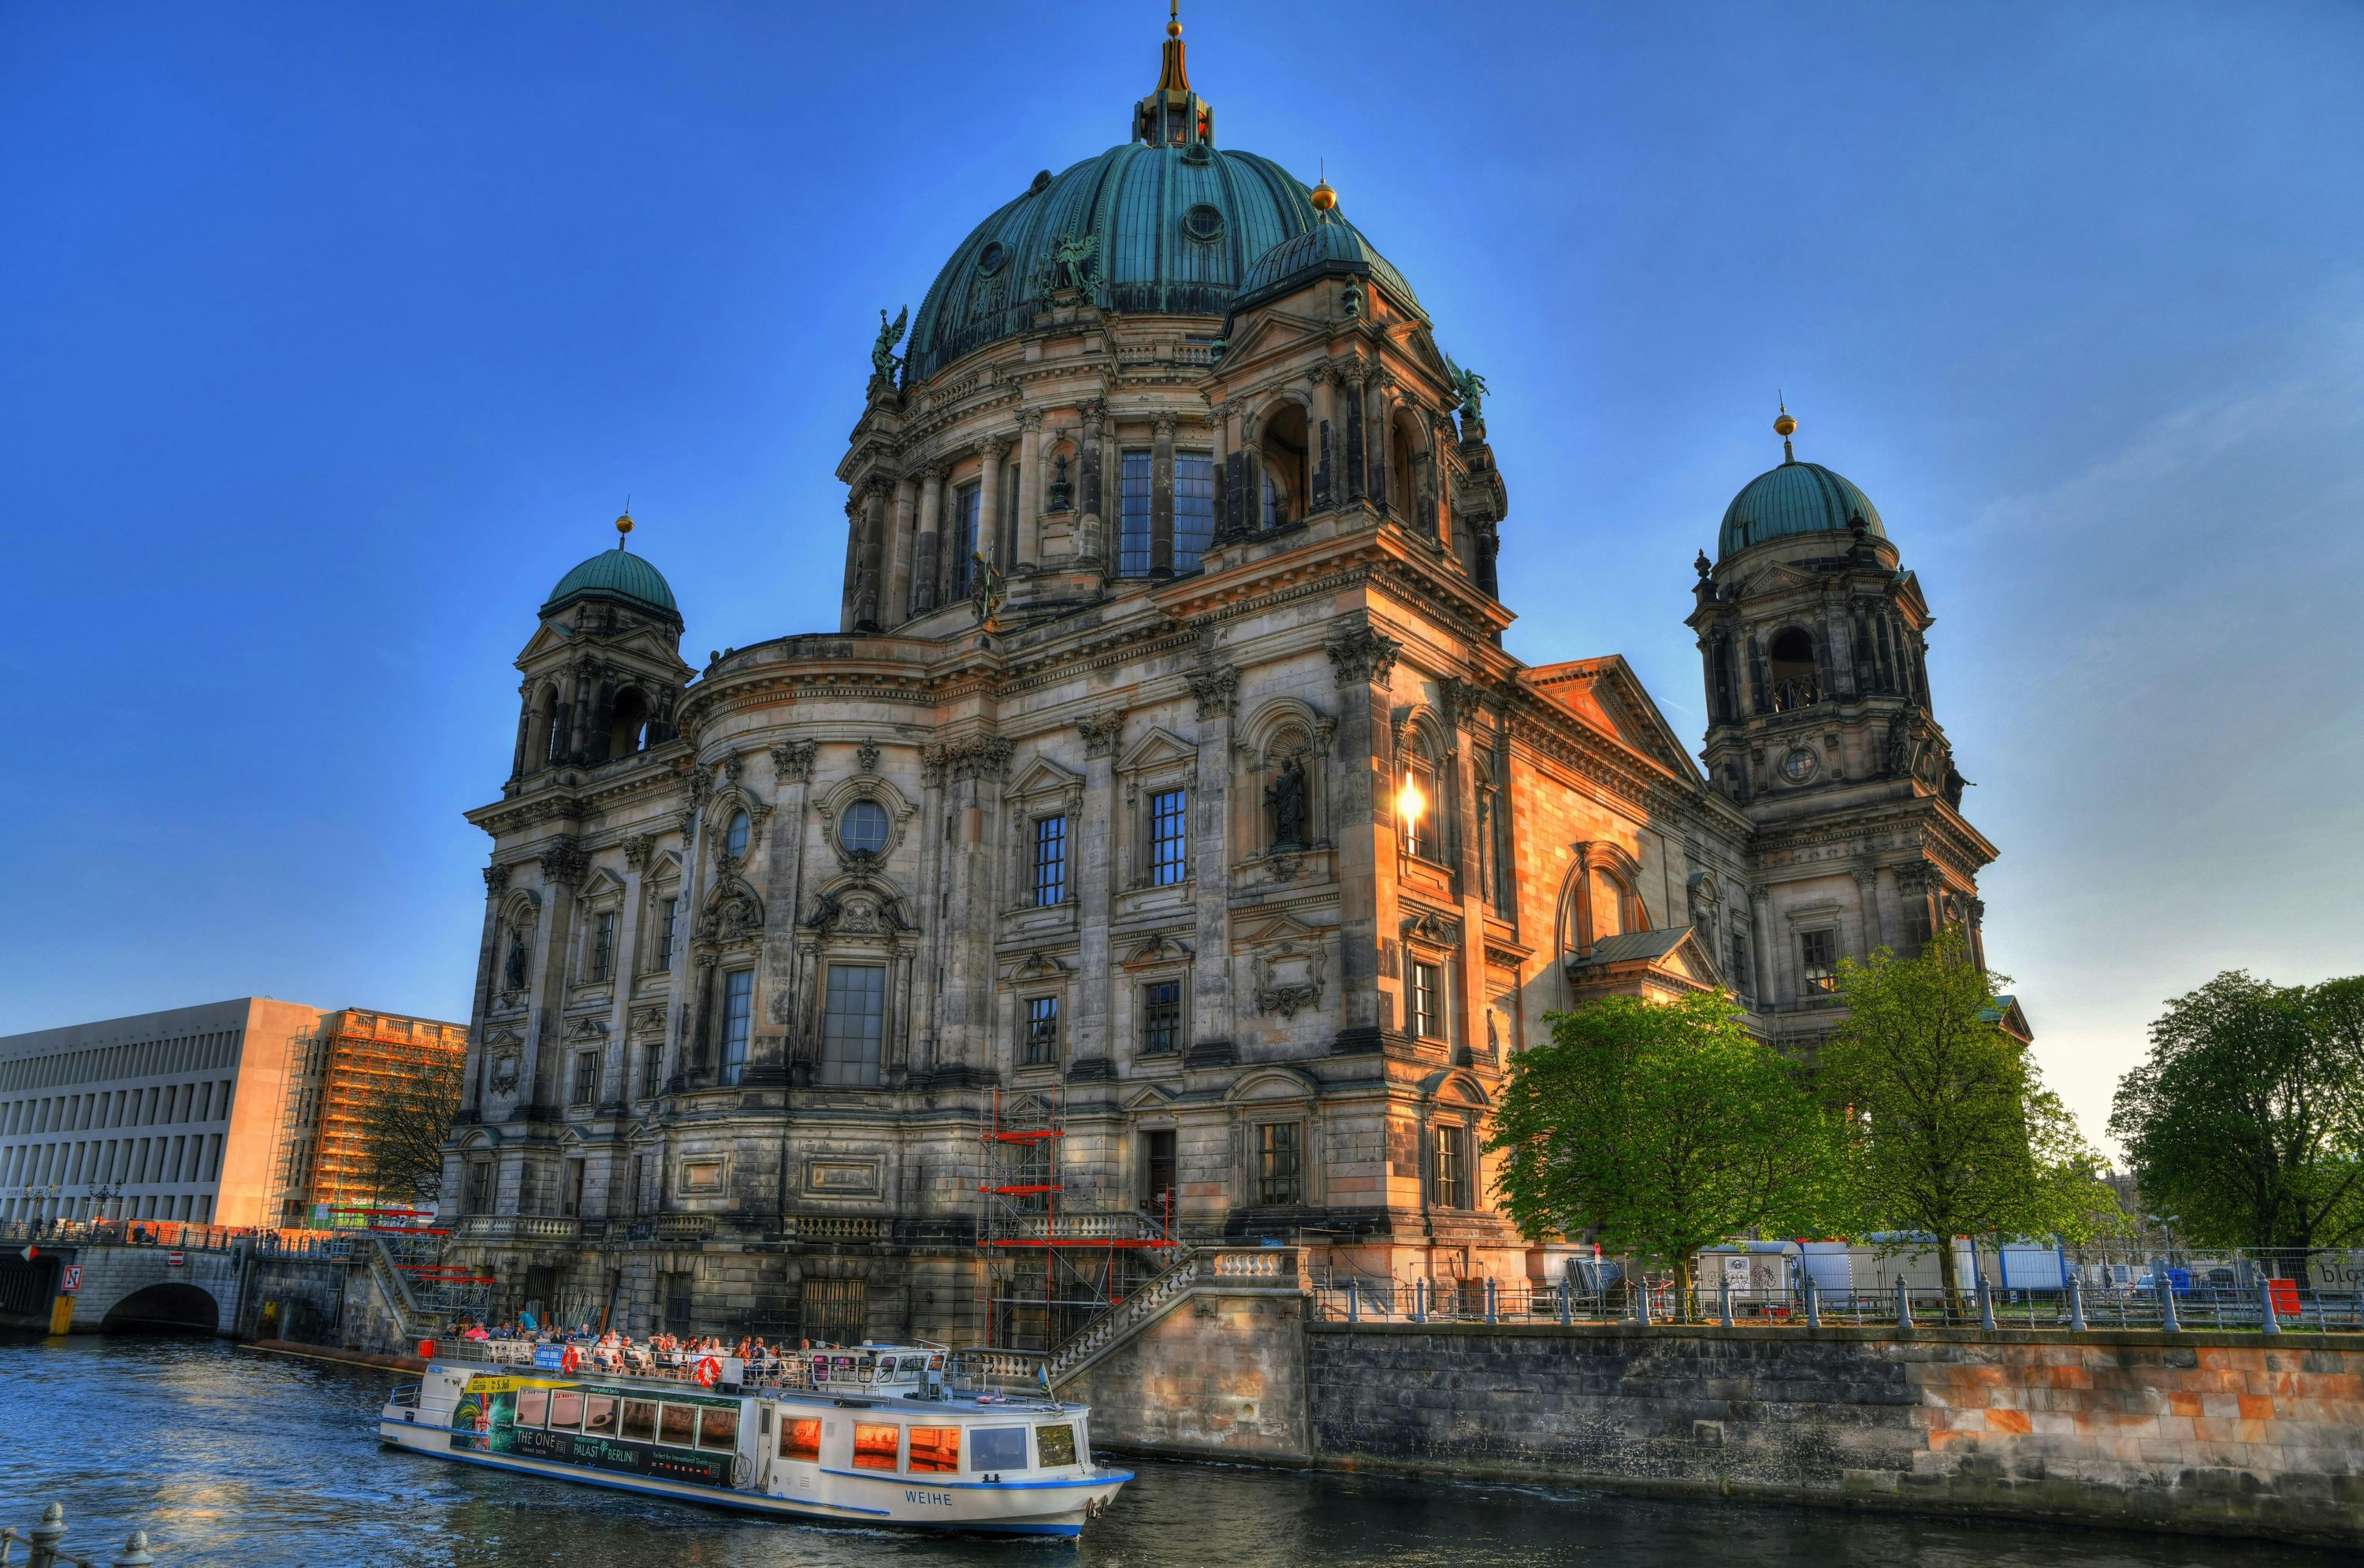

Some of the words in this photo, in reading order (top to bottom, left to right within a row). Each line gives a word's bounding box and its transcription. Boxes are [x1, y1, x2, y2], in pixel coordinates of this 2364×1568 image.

[517, 1431, 533, 1444] THE
[536, 1433, 556, 1447] ONE
[574, 1444, 599, 1458] PALAST
[608, 1449, 633, 1462] BERLIN
[671, 1455, 695, 1463] International
[905, 1490, 953, 1506] WEIHE
